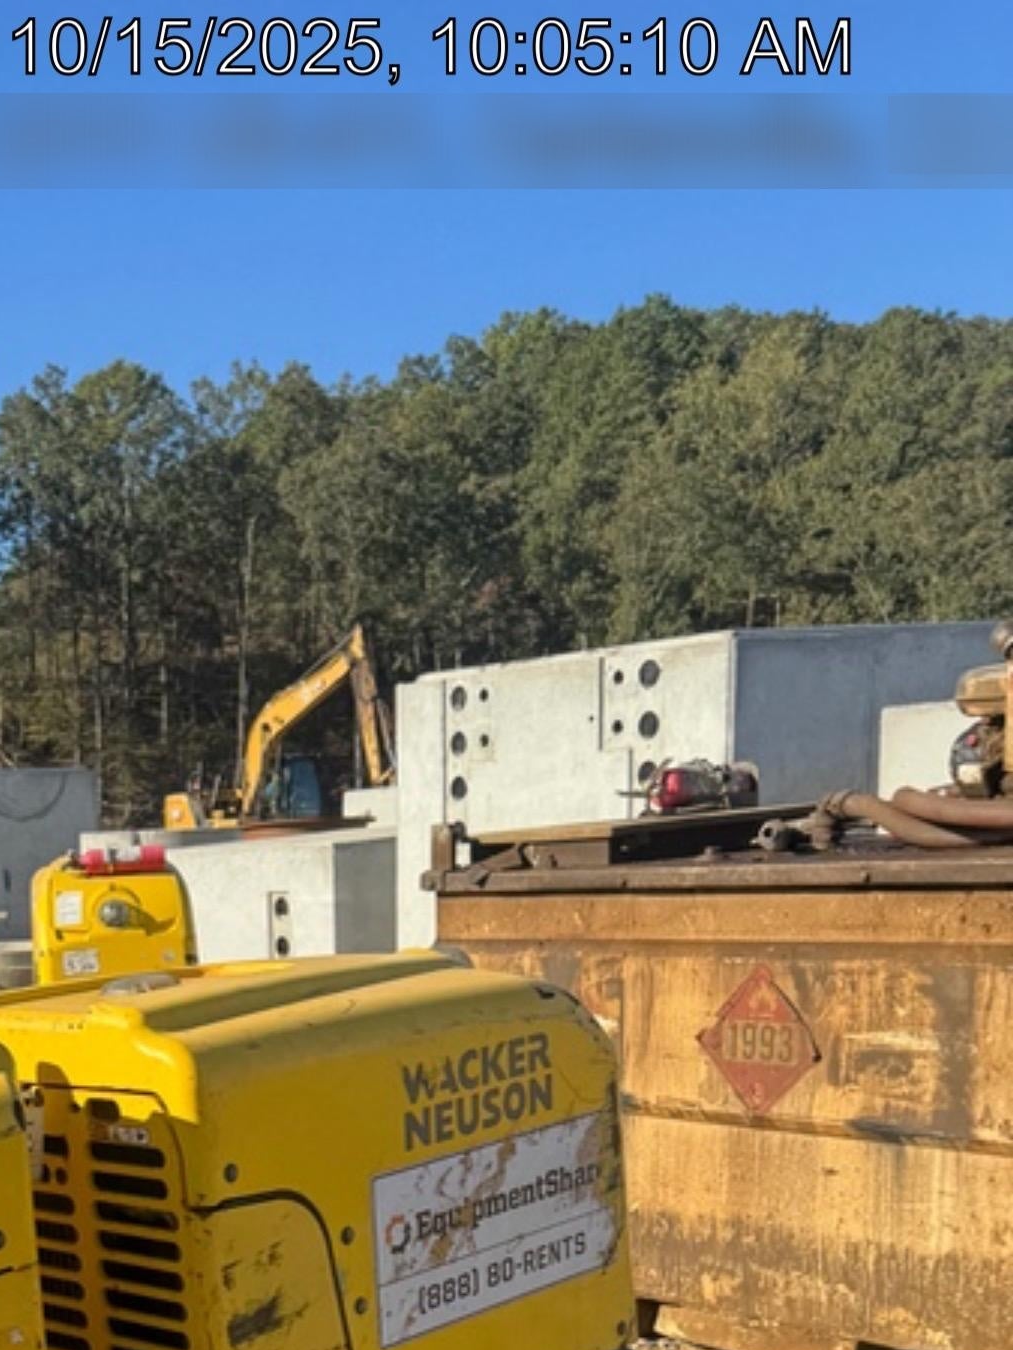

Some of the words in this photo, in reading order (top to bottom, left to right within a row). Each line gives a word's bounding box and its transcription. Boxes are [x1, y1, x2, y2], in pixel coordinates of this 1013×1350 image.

[401, 1031, 552, 1104] WACKER
[727, 1022, 792, 1063] 1993
[403, 1073, 553, 1152] NEUSON
[417, 1267, 480, 1315] (888)
[487, 1231, 587, 1288] 80-RENTS
